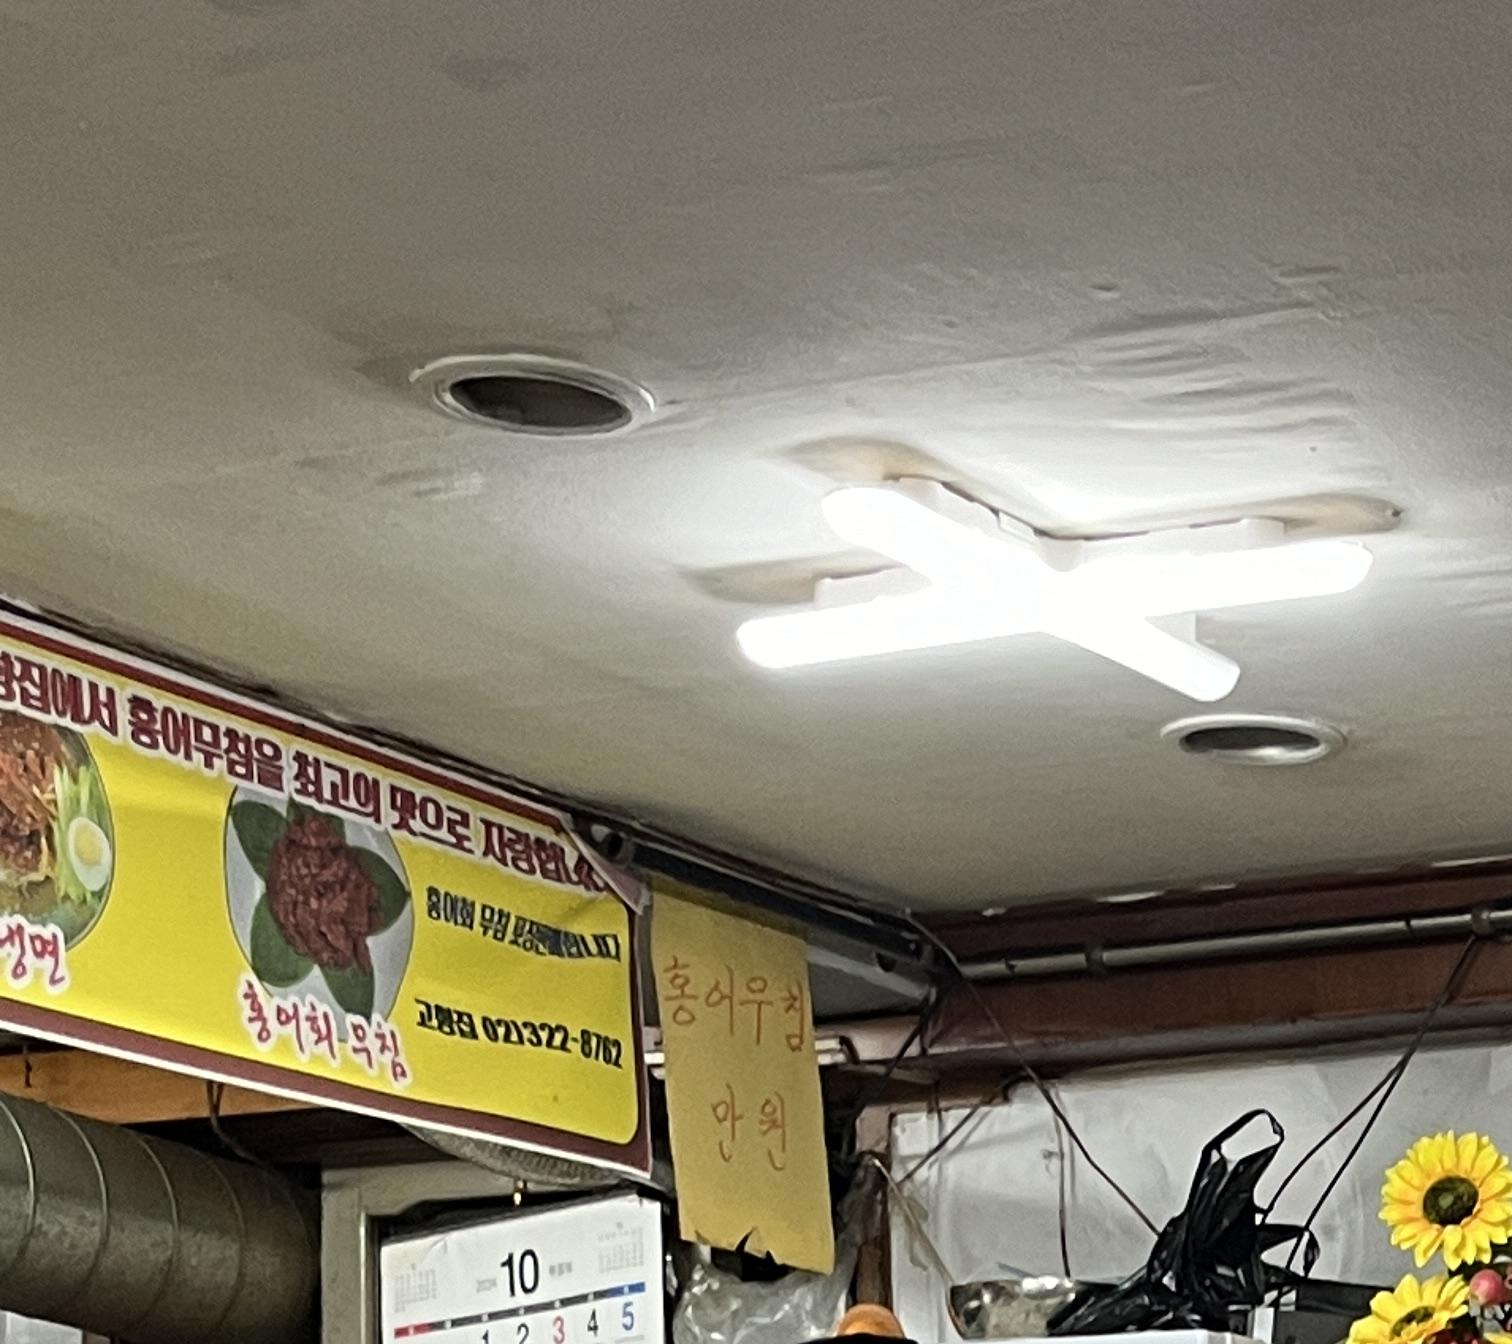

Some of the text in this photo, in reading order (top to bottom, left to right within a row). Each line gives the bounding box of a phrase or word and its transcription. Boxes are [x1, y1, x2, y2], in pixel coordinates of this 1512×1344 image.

[128, 694, 284, 792] 홍어무침을
[293, 751, 382, 824] 최고의
[389, 784, 474, 854] 맛으로
[479, 817, 607, 892] 자랑합니
[426, 885, 476, 931] 홍어회
[479, 903, 510, 942] 무침
[243, 980, 407, 1082] 홍어회 무침
[481, 1016, 623, 1069] 02)322-8762
[500, 1249, 541, 1297] 10
[553, 1316, 565, 1344] 3
[587, 1309, 598, 1337] 4
[622, 1302, 635, 1331] 5
